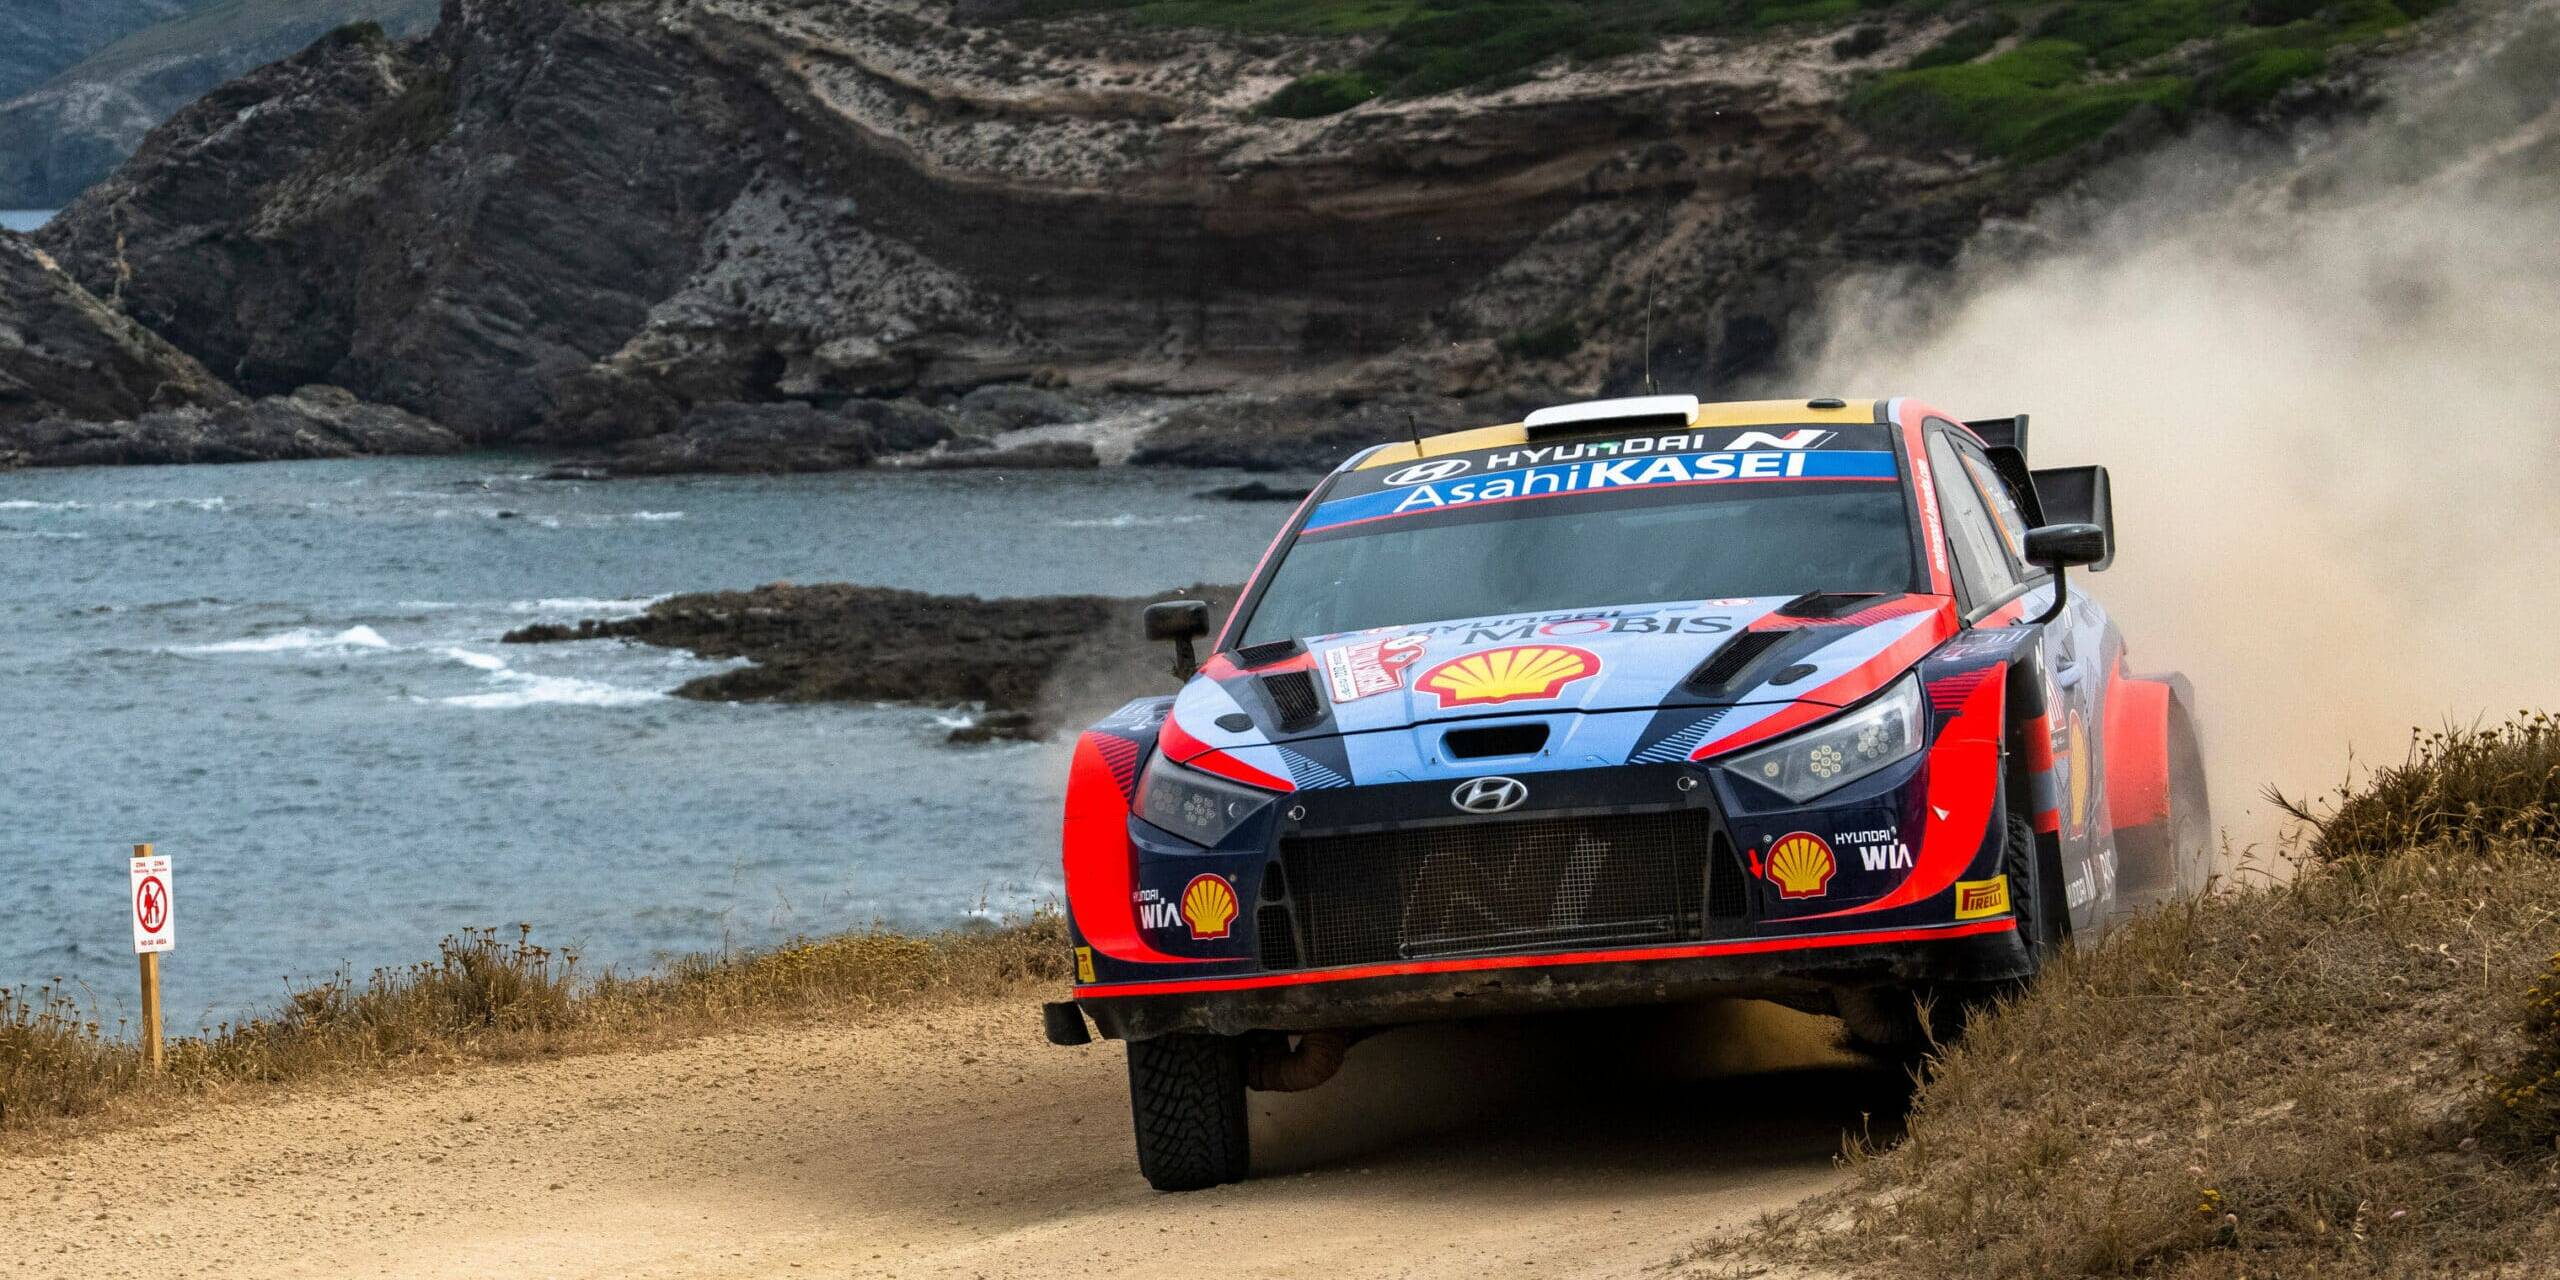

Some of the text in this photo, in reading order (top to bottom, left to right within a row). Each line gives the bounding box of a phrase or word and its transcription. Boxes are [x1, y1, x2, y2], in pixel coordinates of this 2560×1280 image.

[1487, 434, 1704, 469] HYUNDAI
[1393, 452, 1806, 514] AsahiKASEI
[1461, 616, 1732, 645] MOBIS
[1835, 830, 1891, 844] HYUNDAI
[1962, 883, 2001, 911] PIRELLI
